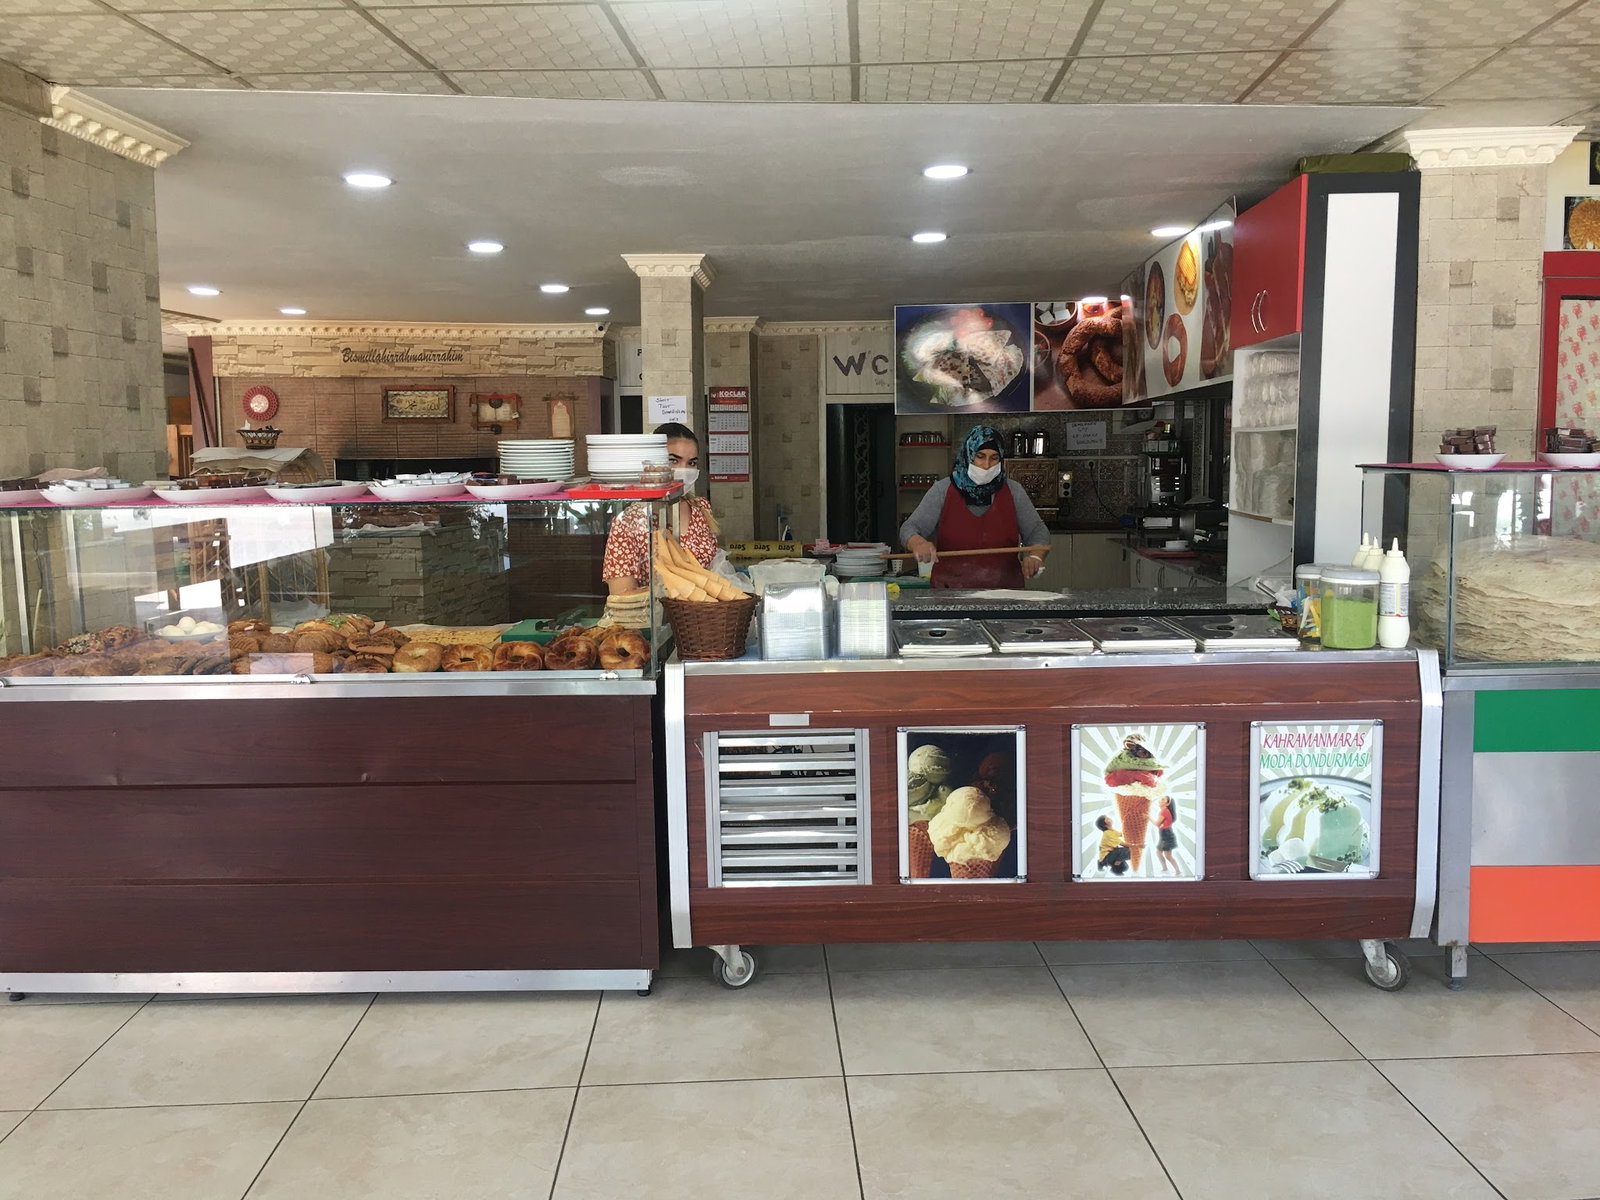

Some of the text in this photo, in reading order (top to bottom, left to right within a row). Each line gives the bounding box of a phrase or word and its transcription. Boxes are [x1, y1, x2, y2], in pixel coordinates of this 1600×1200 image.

[341, 347, 463, 363] Bismillahirrahmanirrahim
[1263, 732, 1366, 750] KAHRAMANMARAŞ
[1260, 752, 1369, 769] MODA DONDURMASI
